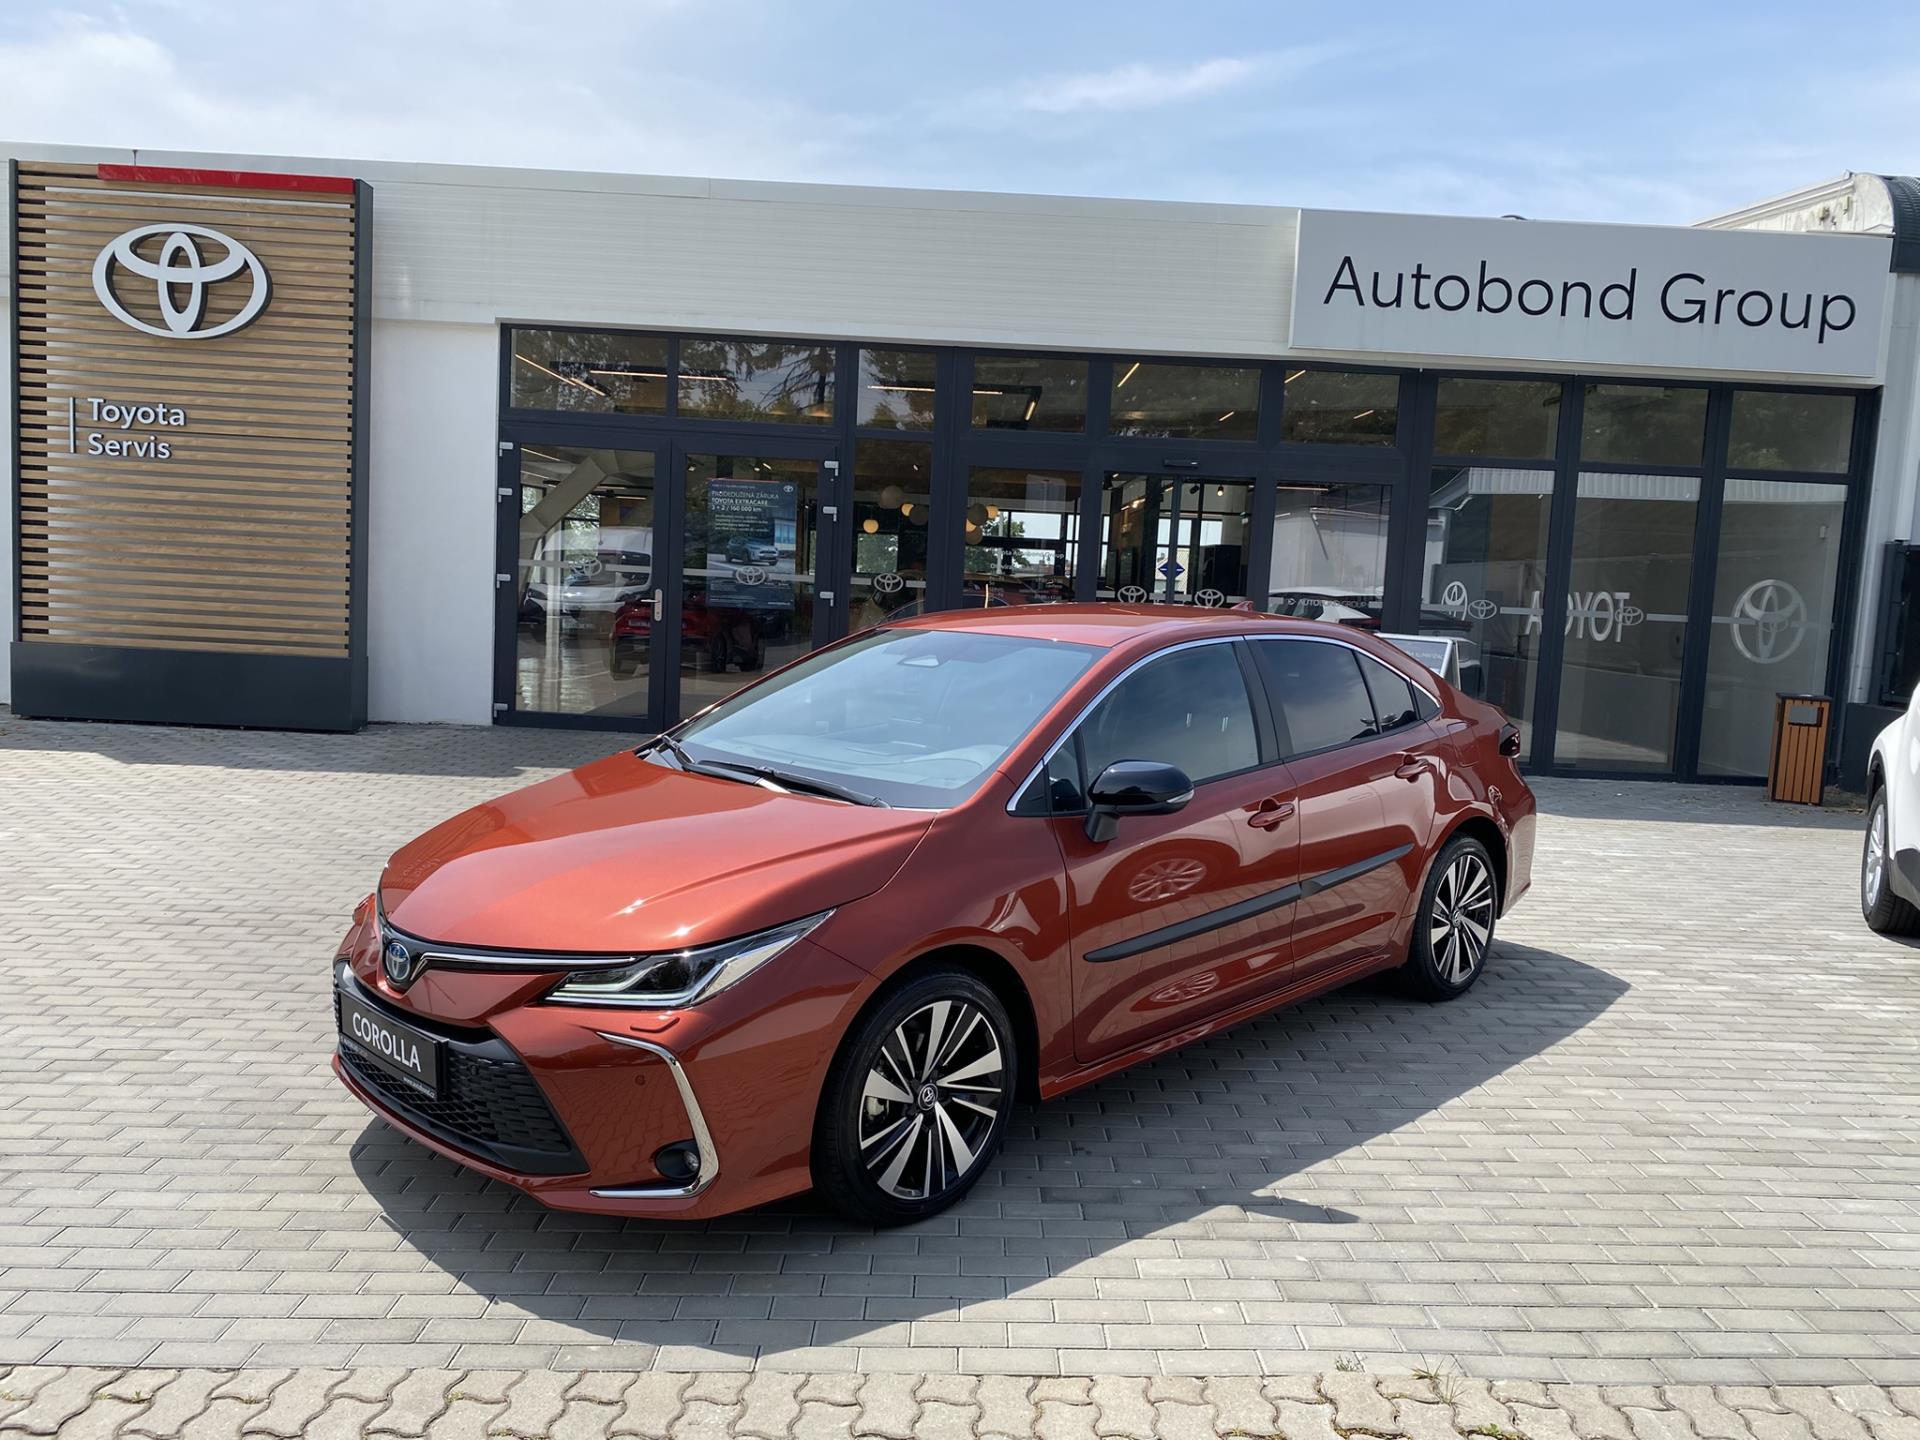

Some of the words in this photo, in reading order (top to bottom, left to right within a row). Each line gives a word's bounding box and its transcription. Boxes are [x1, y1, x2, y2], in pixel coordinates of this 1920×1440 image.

[1323, 255, 1637, 321] Autobond
[1660, 272, 1857, 344] Group
[87, 397, 186, 429] Toyota
[87, 433, 172, 459] Servis
[352, 1011, 421, 1073] COROLLA
